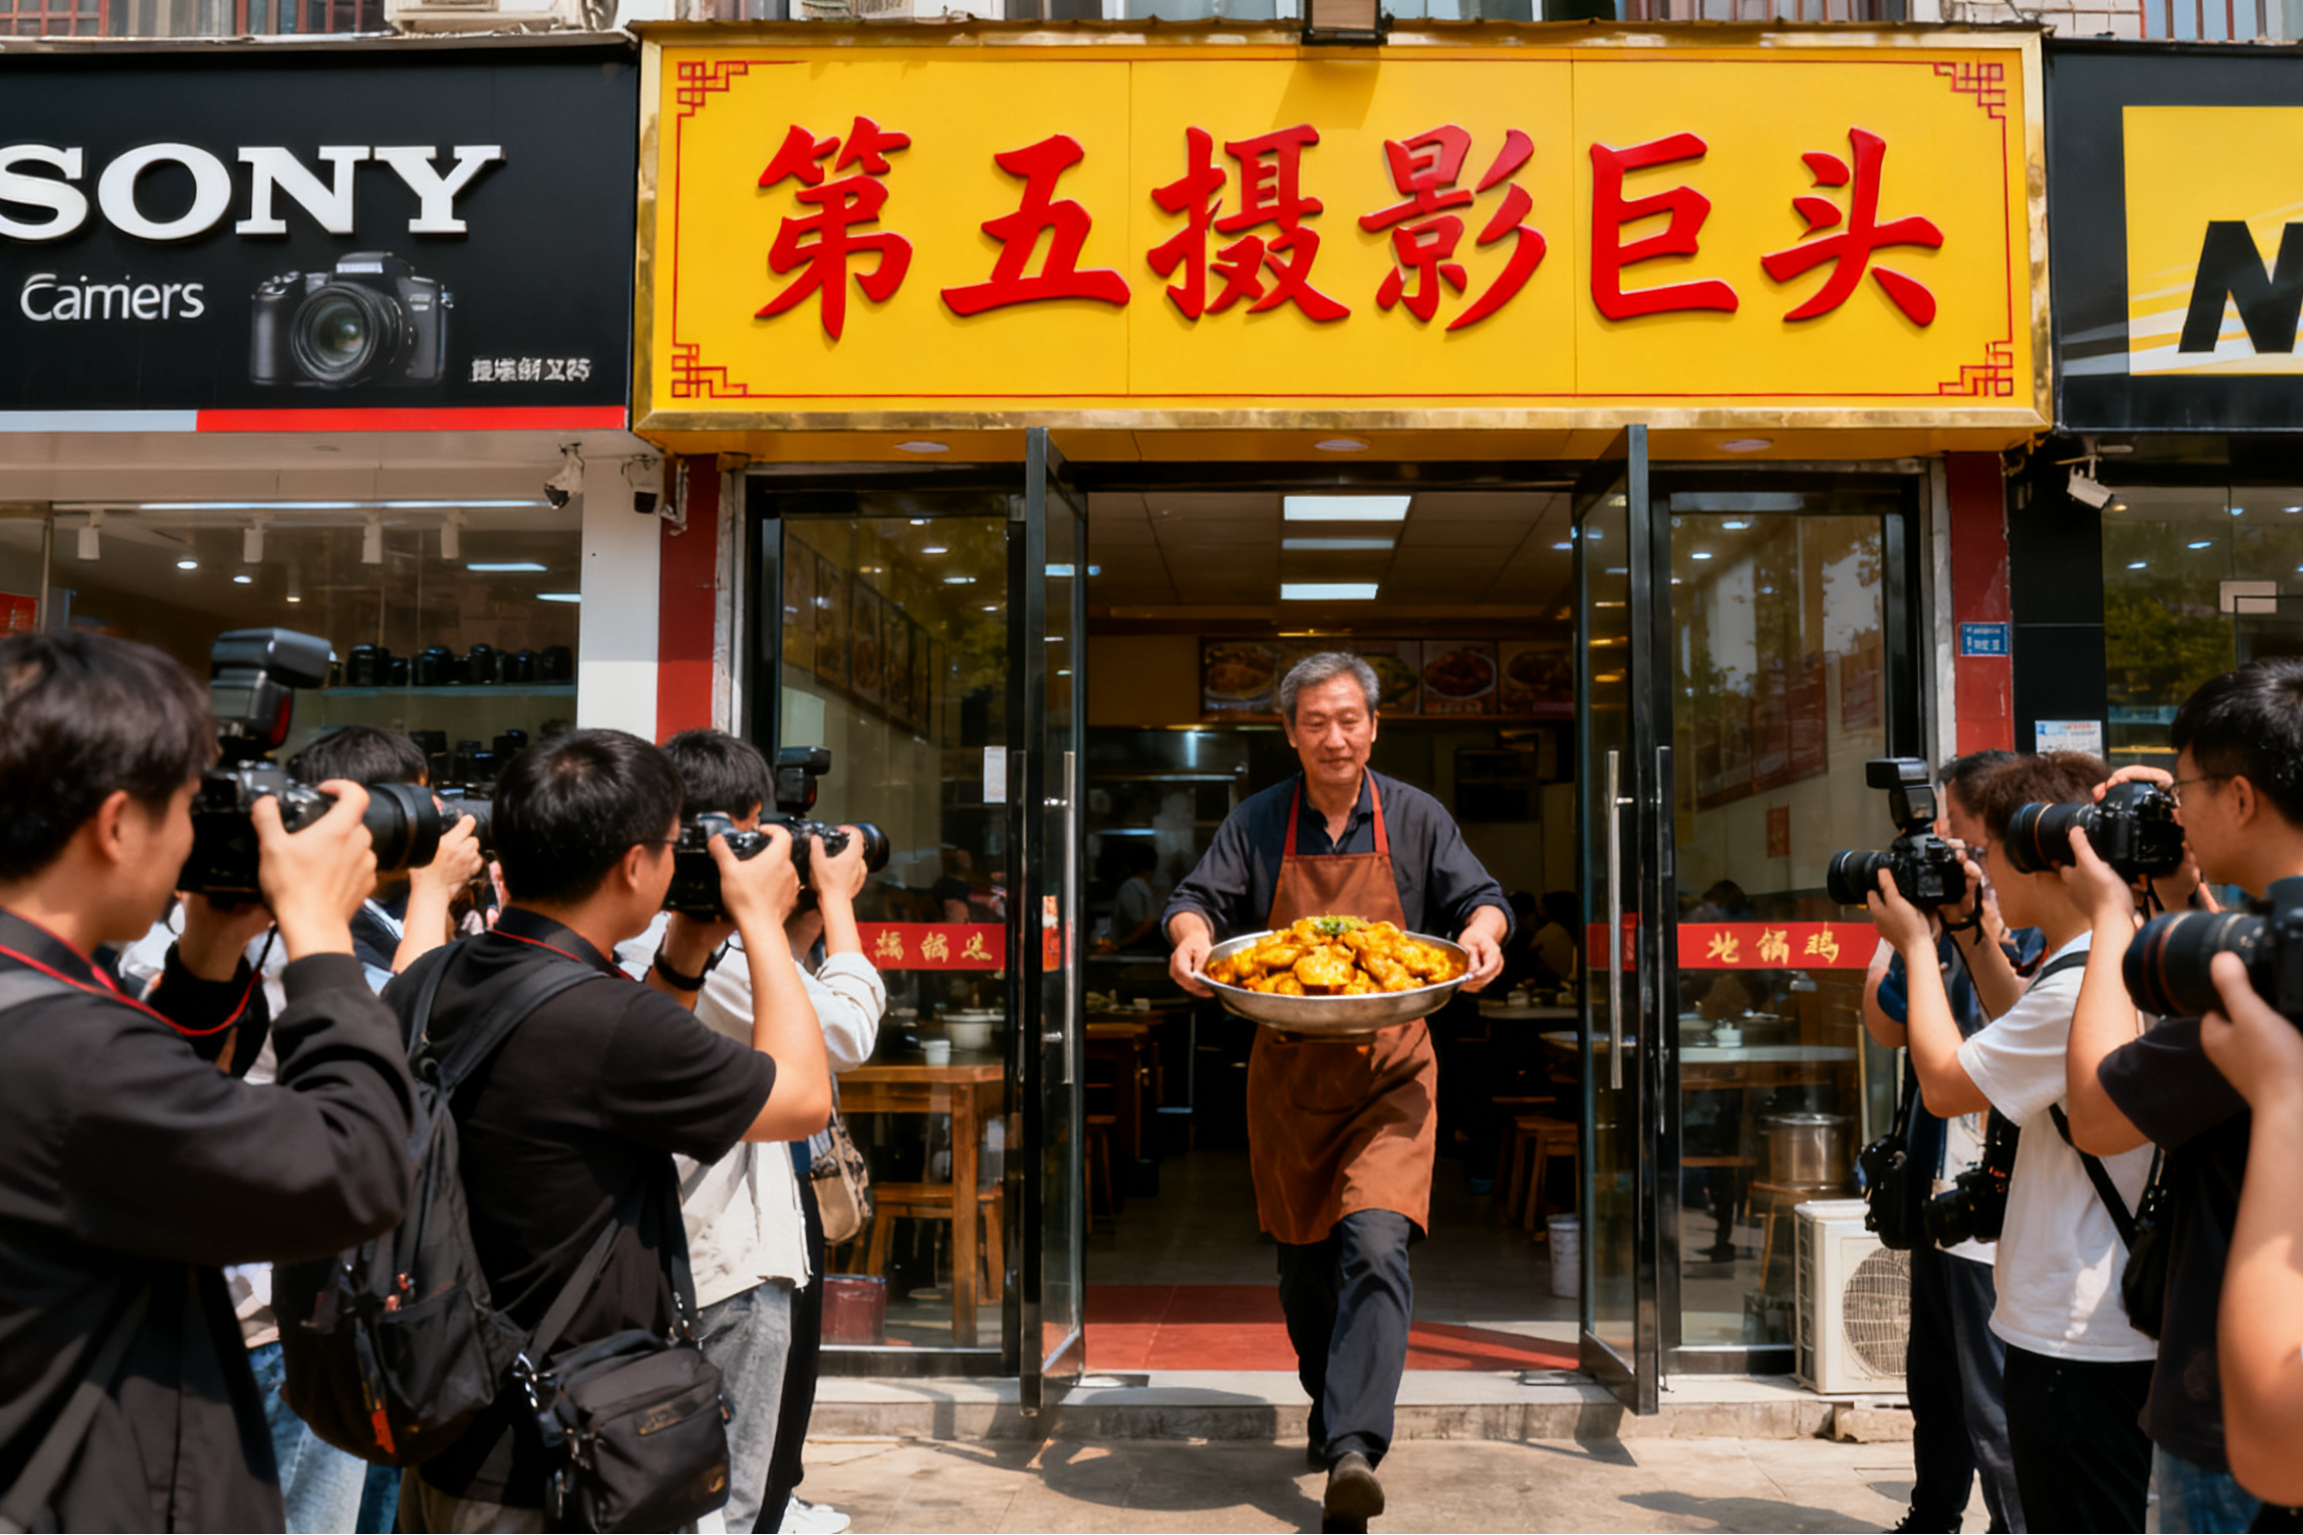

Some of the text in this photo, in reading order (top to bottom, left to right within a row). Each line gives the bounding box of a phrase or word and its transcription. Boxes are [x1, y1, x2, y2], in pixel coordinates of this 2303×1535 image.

[0, 142, 504, 240] SONY
[754, 116, 1944, 341] 第五摄影巨头
